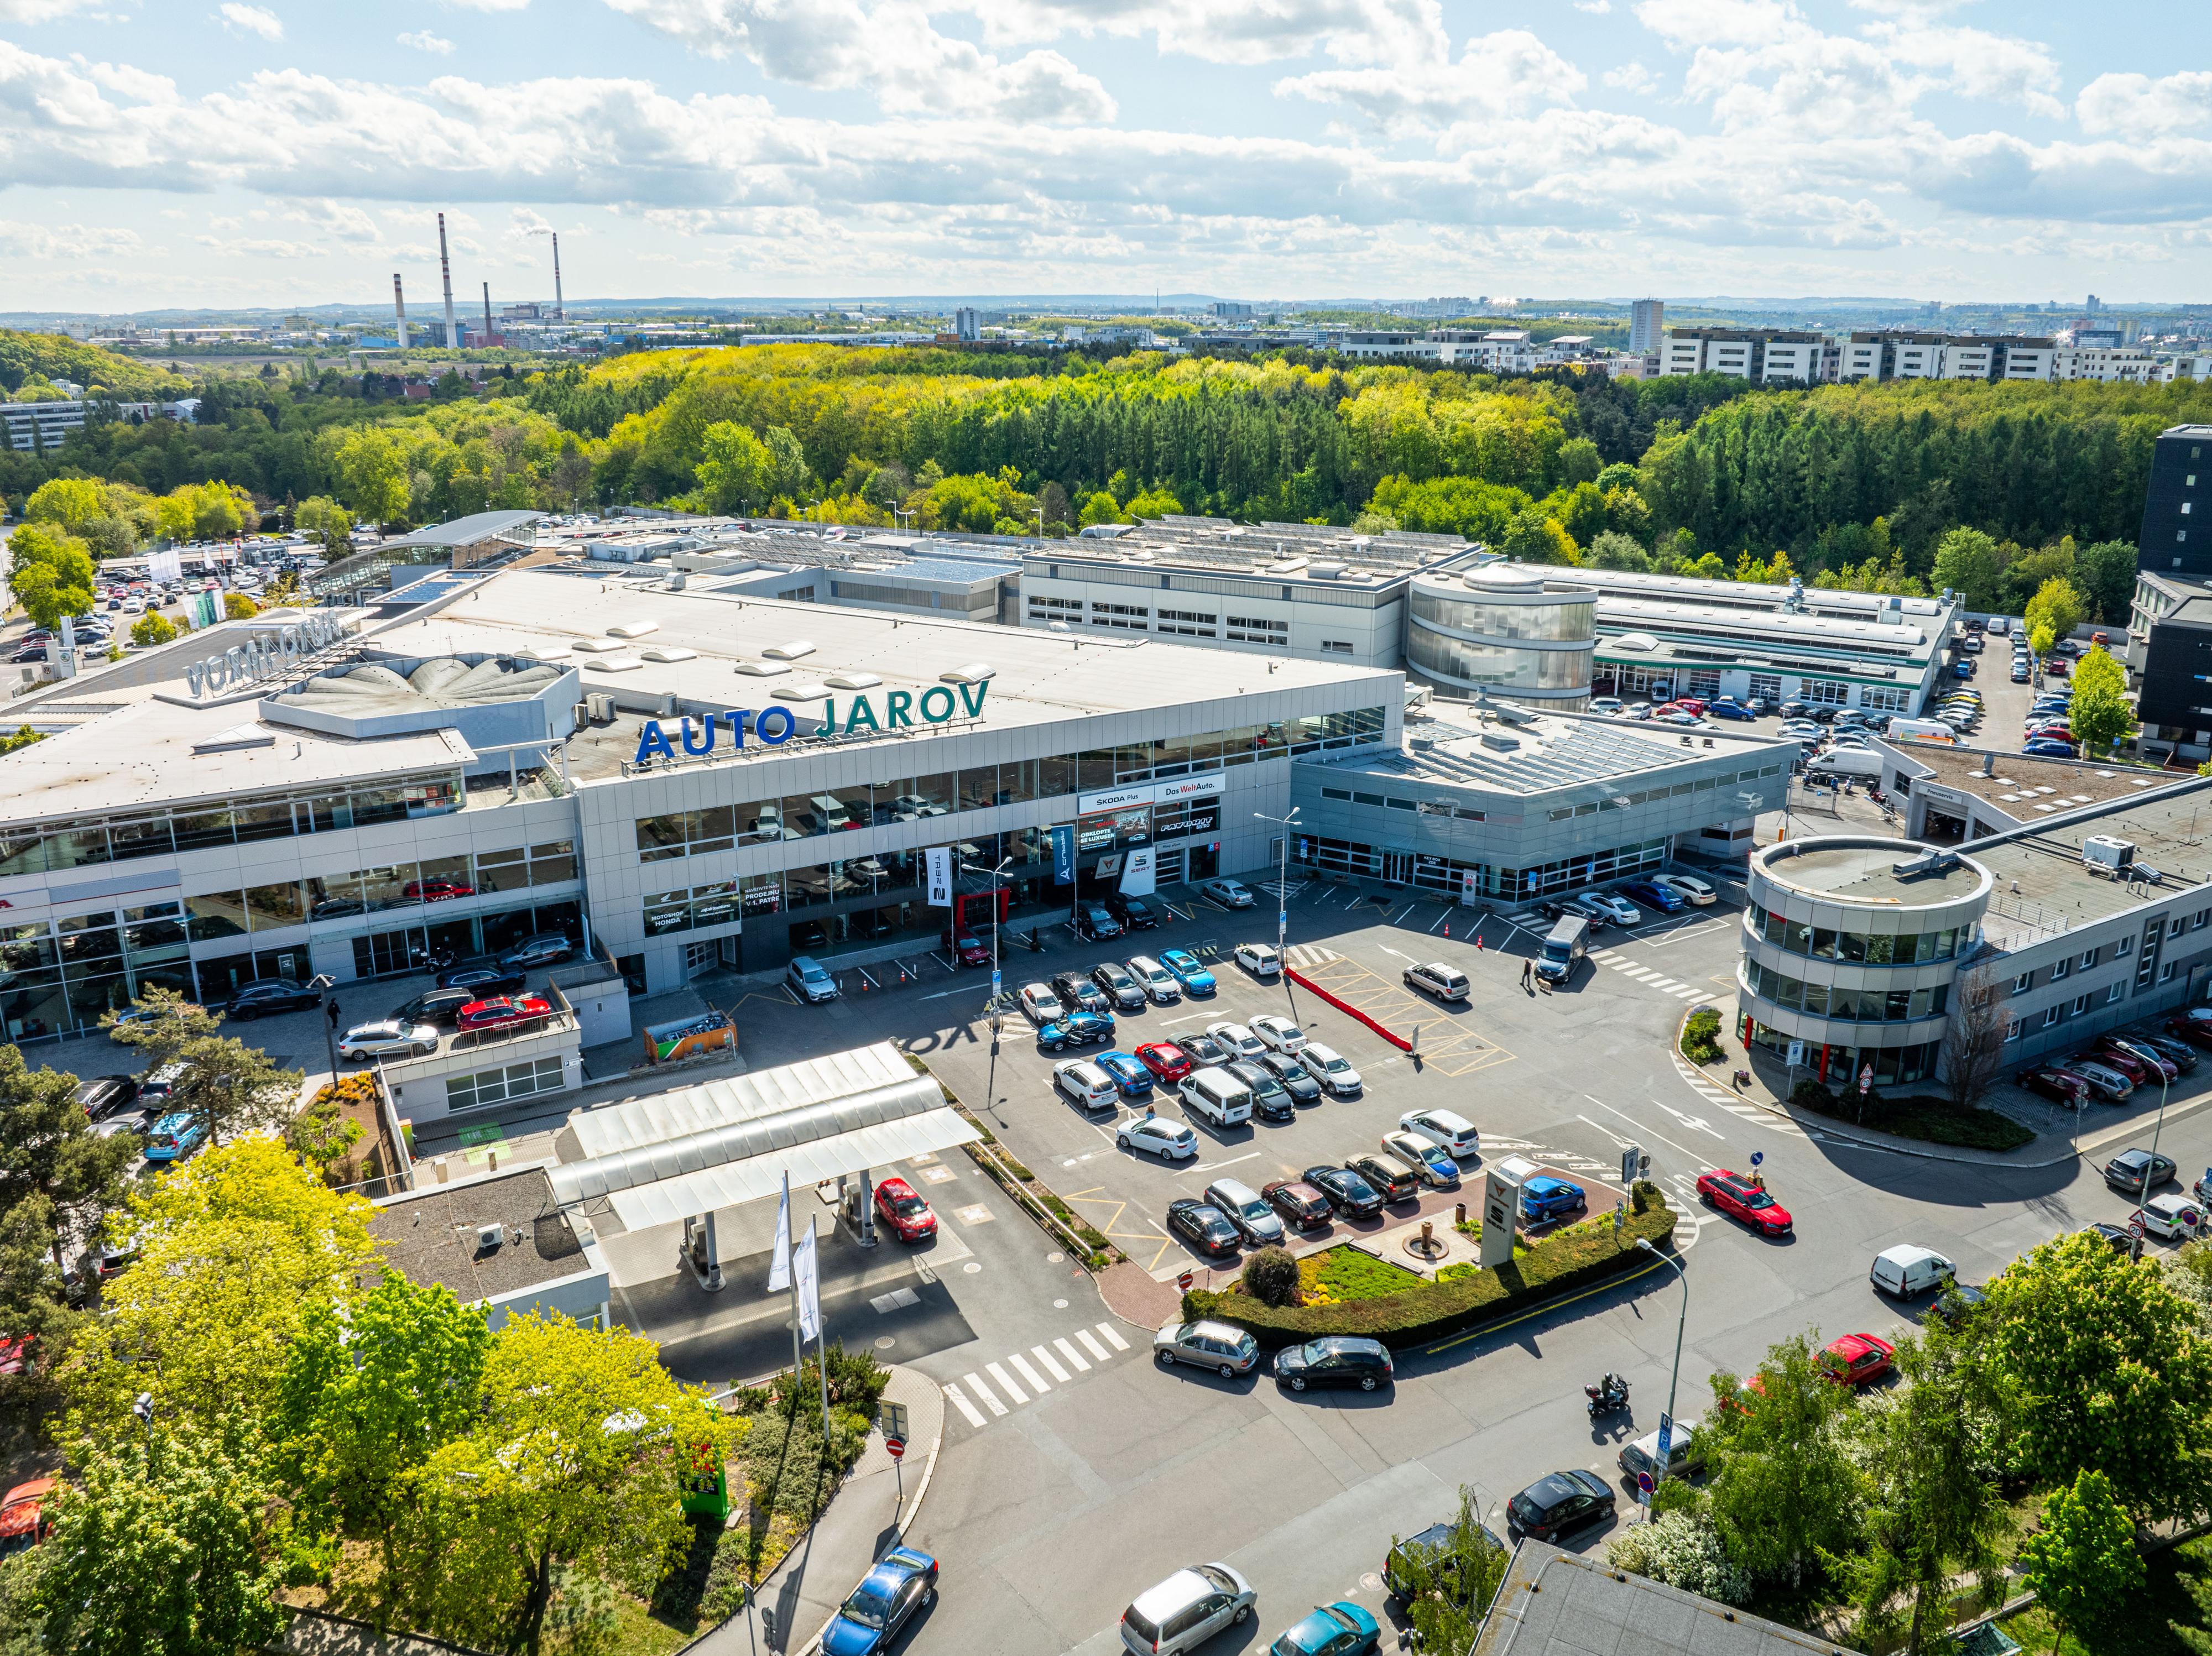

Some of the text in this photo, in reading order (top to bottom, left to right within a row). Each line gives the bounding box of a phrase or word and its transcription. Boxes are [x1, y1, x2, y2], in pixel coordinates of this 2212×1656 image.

[634, 680, 990, 763] AUTO JAROV
[1166, 787, 1180, 796] Das
[1927, 788, 1953, 800] Pneuservis
[1097, 796, 1125, 806] ŠKODA
[1160, 817, 1213, 832] FAVORIT
[1081, 828, 1111, 838] OBKLOPTE
[745, 889, 780, 900] PRODEJNU
[651, 911, 684, 921] MOTOSHOP
[655, 917, 681, 927] HONDA
[1486, 1217, 1507, 1233] SEAT
[2131, 1226, 2141, 1236] 20
